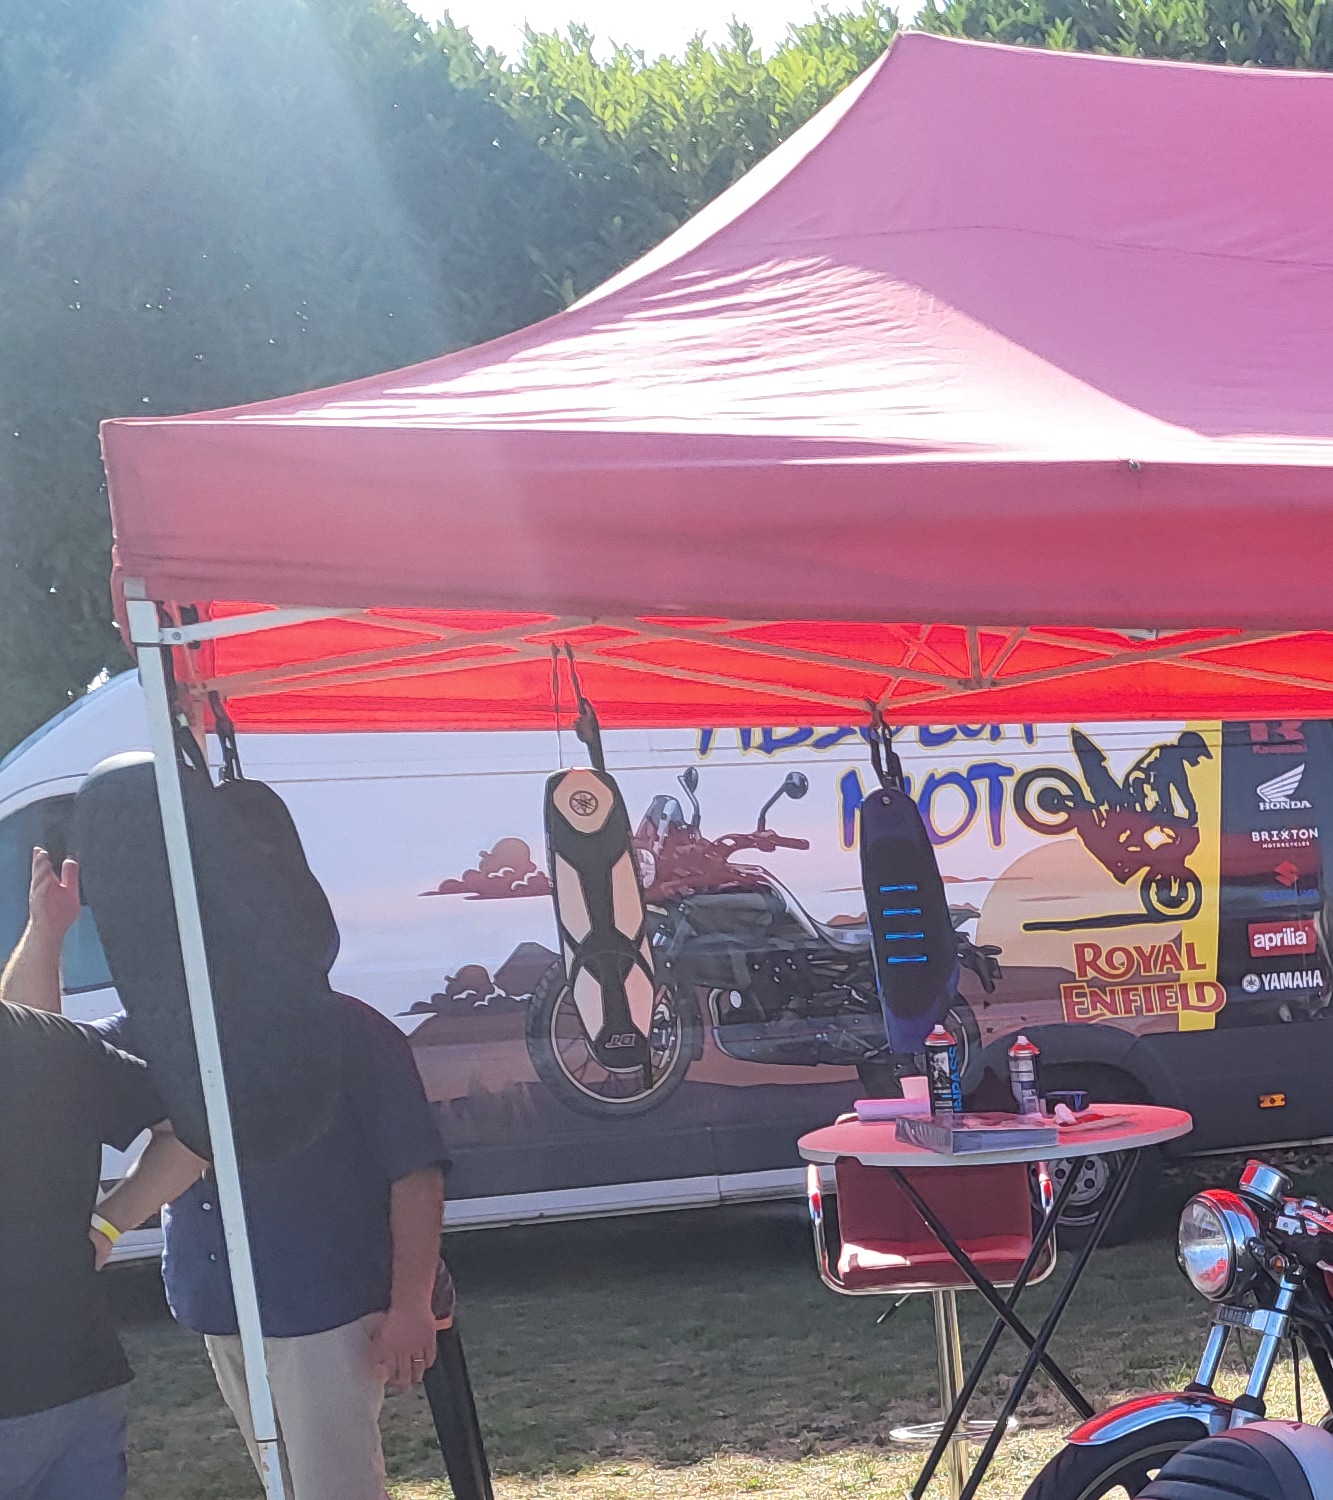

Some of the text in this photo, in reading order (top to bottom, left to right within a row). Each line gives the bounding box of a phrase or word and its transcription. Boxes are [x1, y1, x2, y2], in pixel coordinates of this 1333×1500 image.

[1258, 800, 1313, 811] HONDA
[1251, 827, 1319, 842] BRIXTON
[1253, 926, 1307, 951] aprilia
[1073, 942, 1207, 982] ROYAL
[1261, 970, 1324, 991] YAMAHA
[1060, 980, 1227, 1024] ENFIELD
